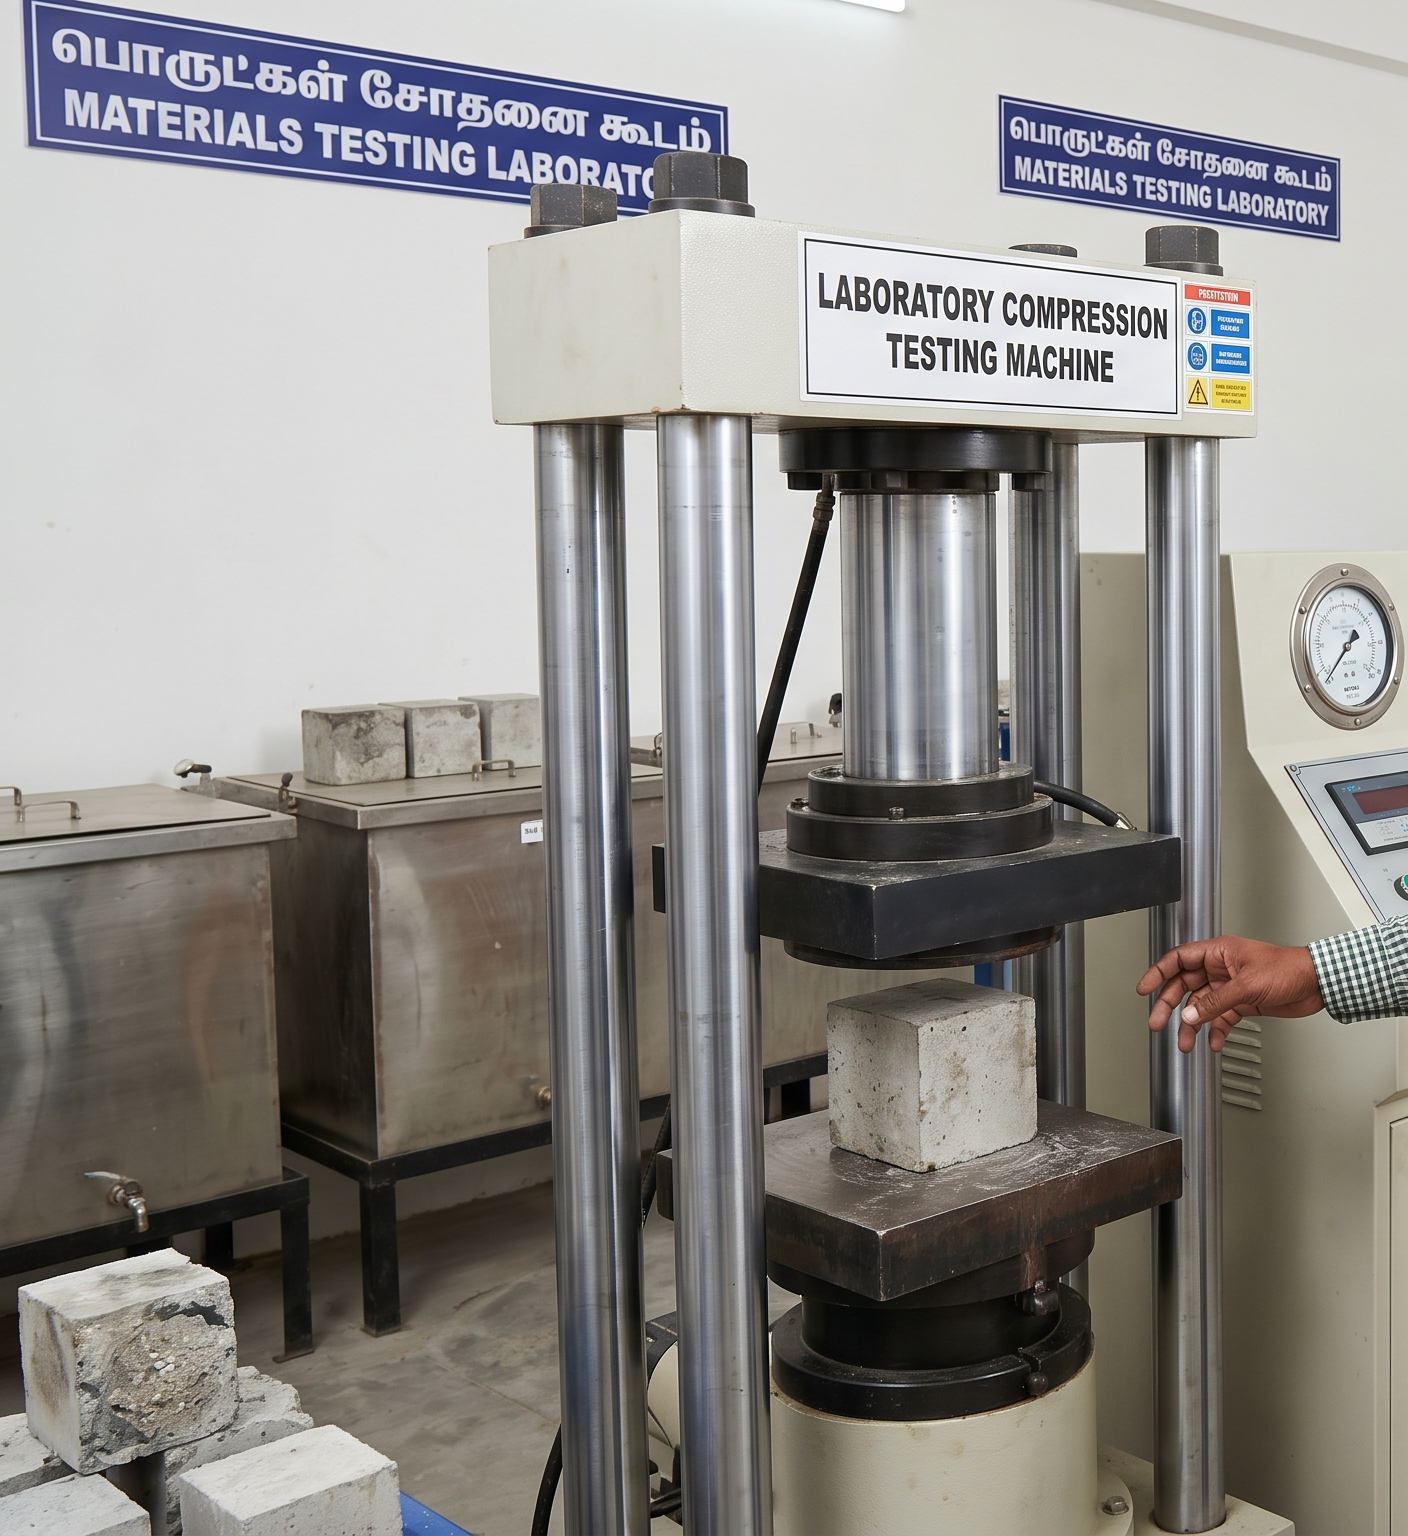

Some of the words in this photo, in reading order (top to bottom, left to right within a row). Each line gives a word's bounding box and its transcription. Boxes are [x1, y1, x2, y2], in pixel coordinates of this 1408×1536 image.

[51, 28, 348, 103] பொருட்கள்
[359, 69, 590, 137] சோதனை
[599, 113, 712, 155] கூடம்
[64, 88, 304, 155] MATERIALS
[314, 121, 476, 176] TESTING
[487, 145, 655, 200] LABORAT
[1009, 116, 1152, 162] பொருட்கள்
[1156, 138, 1270, 182] சோதனை
[1273, 165, 1332, 192] கூடம்
[1014, 155, 1128, 196] MATERIALS
[1132, 174, 1212, 209] TESTING
[1216, 187, 1330, 227] LABORATORY
[818, 272, 995, 325] LABORATORY
[1002, 291, 1168, 340] COMPRESSION
[886, 332, 997, 376] TESTING
[1006, 342, 1114, 383] MACHINE
